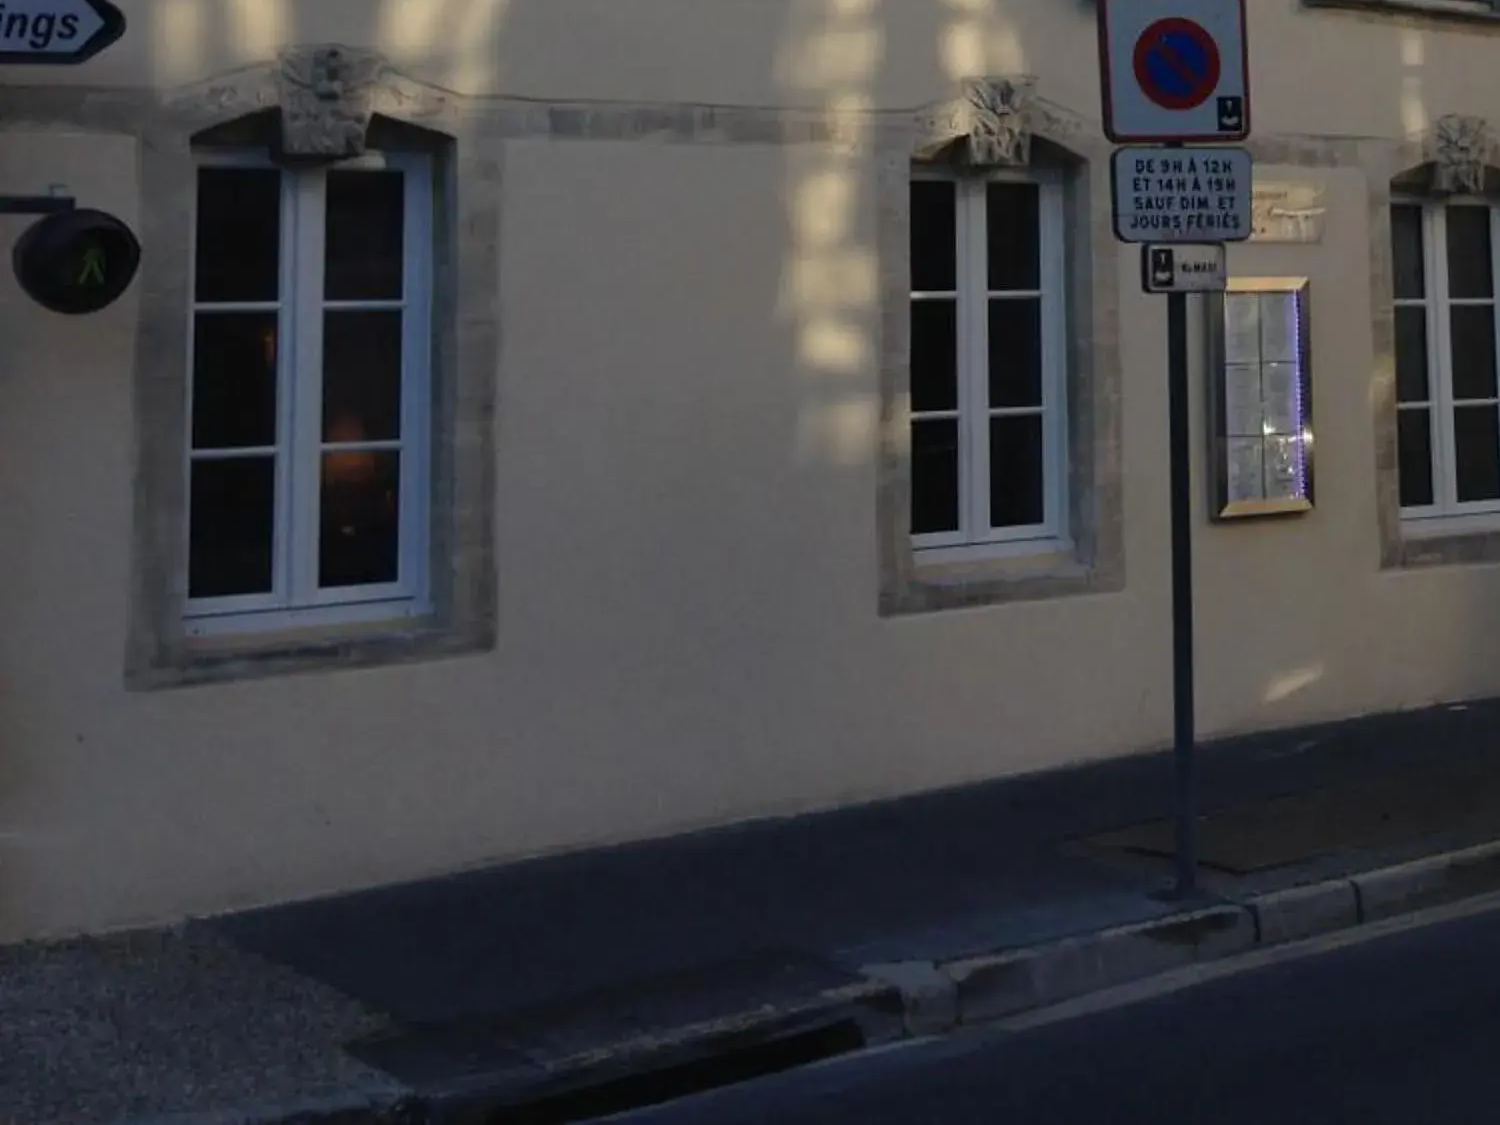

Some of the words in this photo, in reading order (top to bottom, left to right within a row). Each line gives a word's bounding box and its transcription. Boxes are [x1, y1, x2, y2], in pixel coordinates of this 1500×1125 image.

[1135, 158, 1155, 174] DE
[1161, 158, 1182, 174] 9H
[1203, 159, 1232, 174] 12H
[1133, 178, 1151, 192] ET
[1157, 178, 1186, 192] 14H
[1134, 195, 1175, 210] SAUF
[1217, 195, 1235, 210] ET
[1130, 214, 1181, 230] JOURS
